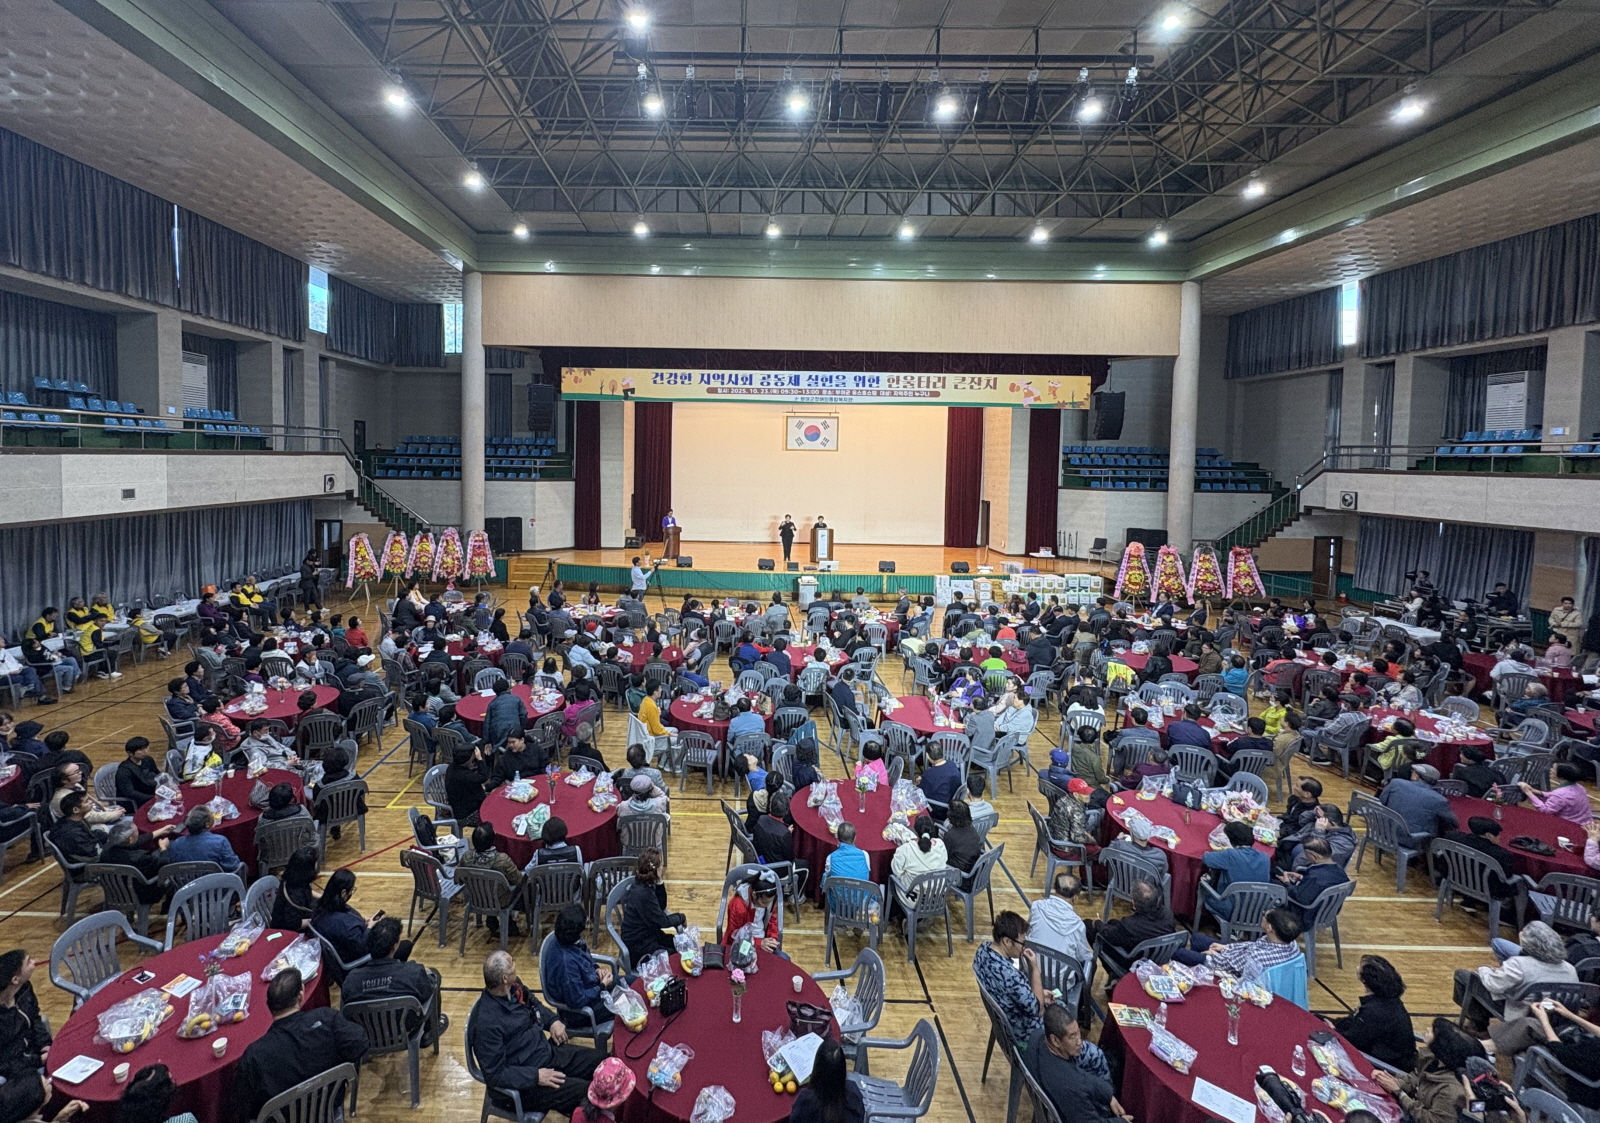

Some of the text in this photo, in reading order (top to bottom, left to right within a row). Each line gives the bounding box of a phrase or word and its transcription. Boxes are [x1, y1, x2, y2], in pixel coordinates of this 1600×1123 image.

[651, 372, 998, 390] 건강한 지역사회 공동체 실현을 위한 한울타리 큰잔치
